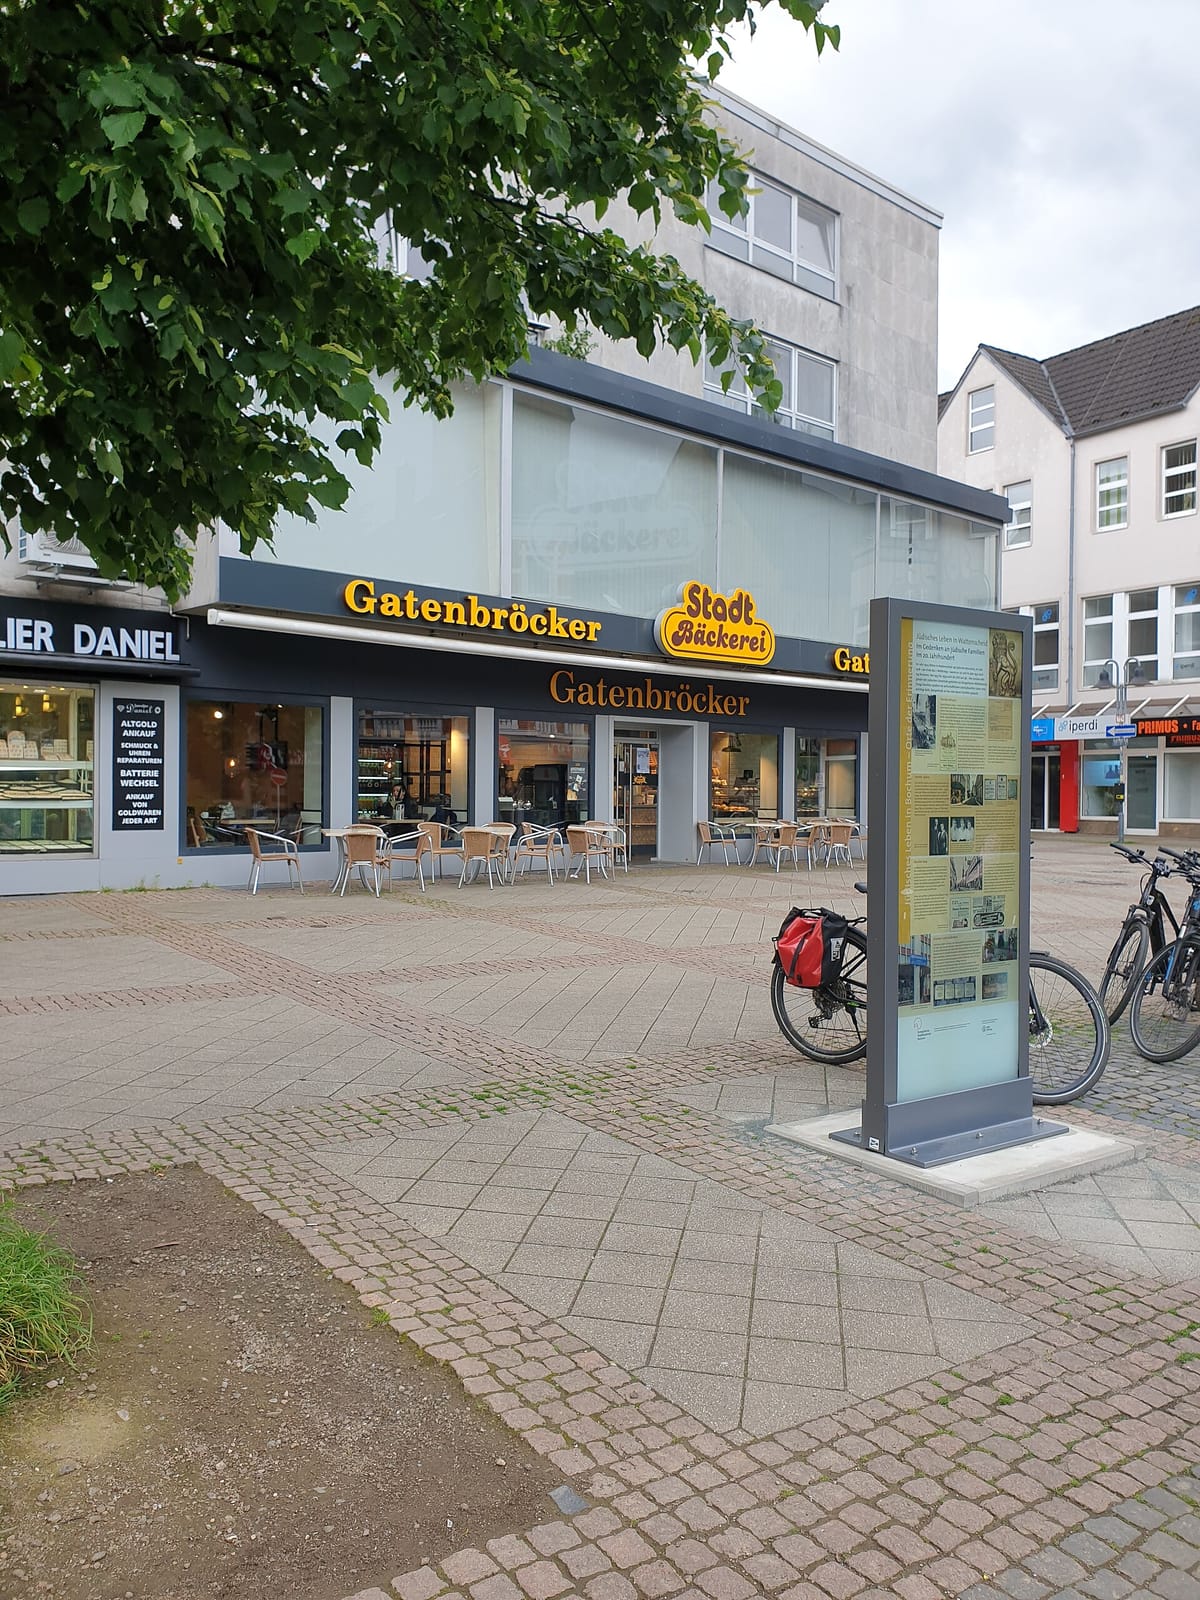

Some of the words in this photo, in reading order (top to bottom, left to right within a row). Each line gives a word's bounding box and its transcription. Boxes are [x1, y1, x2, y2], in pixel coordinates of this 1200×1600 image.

[344, 579, 601, 642] Gatenbröcker
[686, 583, 754, 625] Stadt
[74, 624, 180, 661] DANIEL
[671, 619, 766, 653] Bäckerei
[549, 669, 750, 716] Gatenbröcker
[121, 720, 158, 728] ALTGOLD
[122, 729, 156, 737] ANKAUF
[1068, 719, 1099, 734] iperdi
[120, 769, 160, 777] BATTERIE
[120, 779, 159, 787] WECHSEL
[904, 761, 912, 805] Bochum
[121, 817, 143, 825] JEDER
[904, 821, 912, 852] Leben
